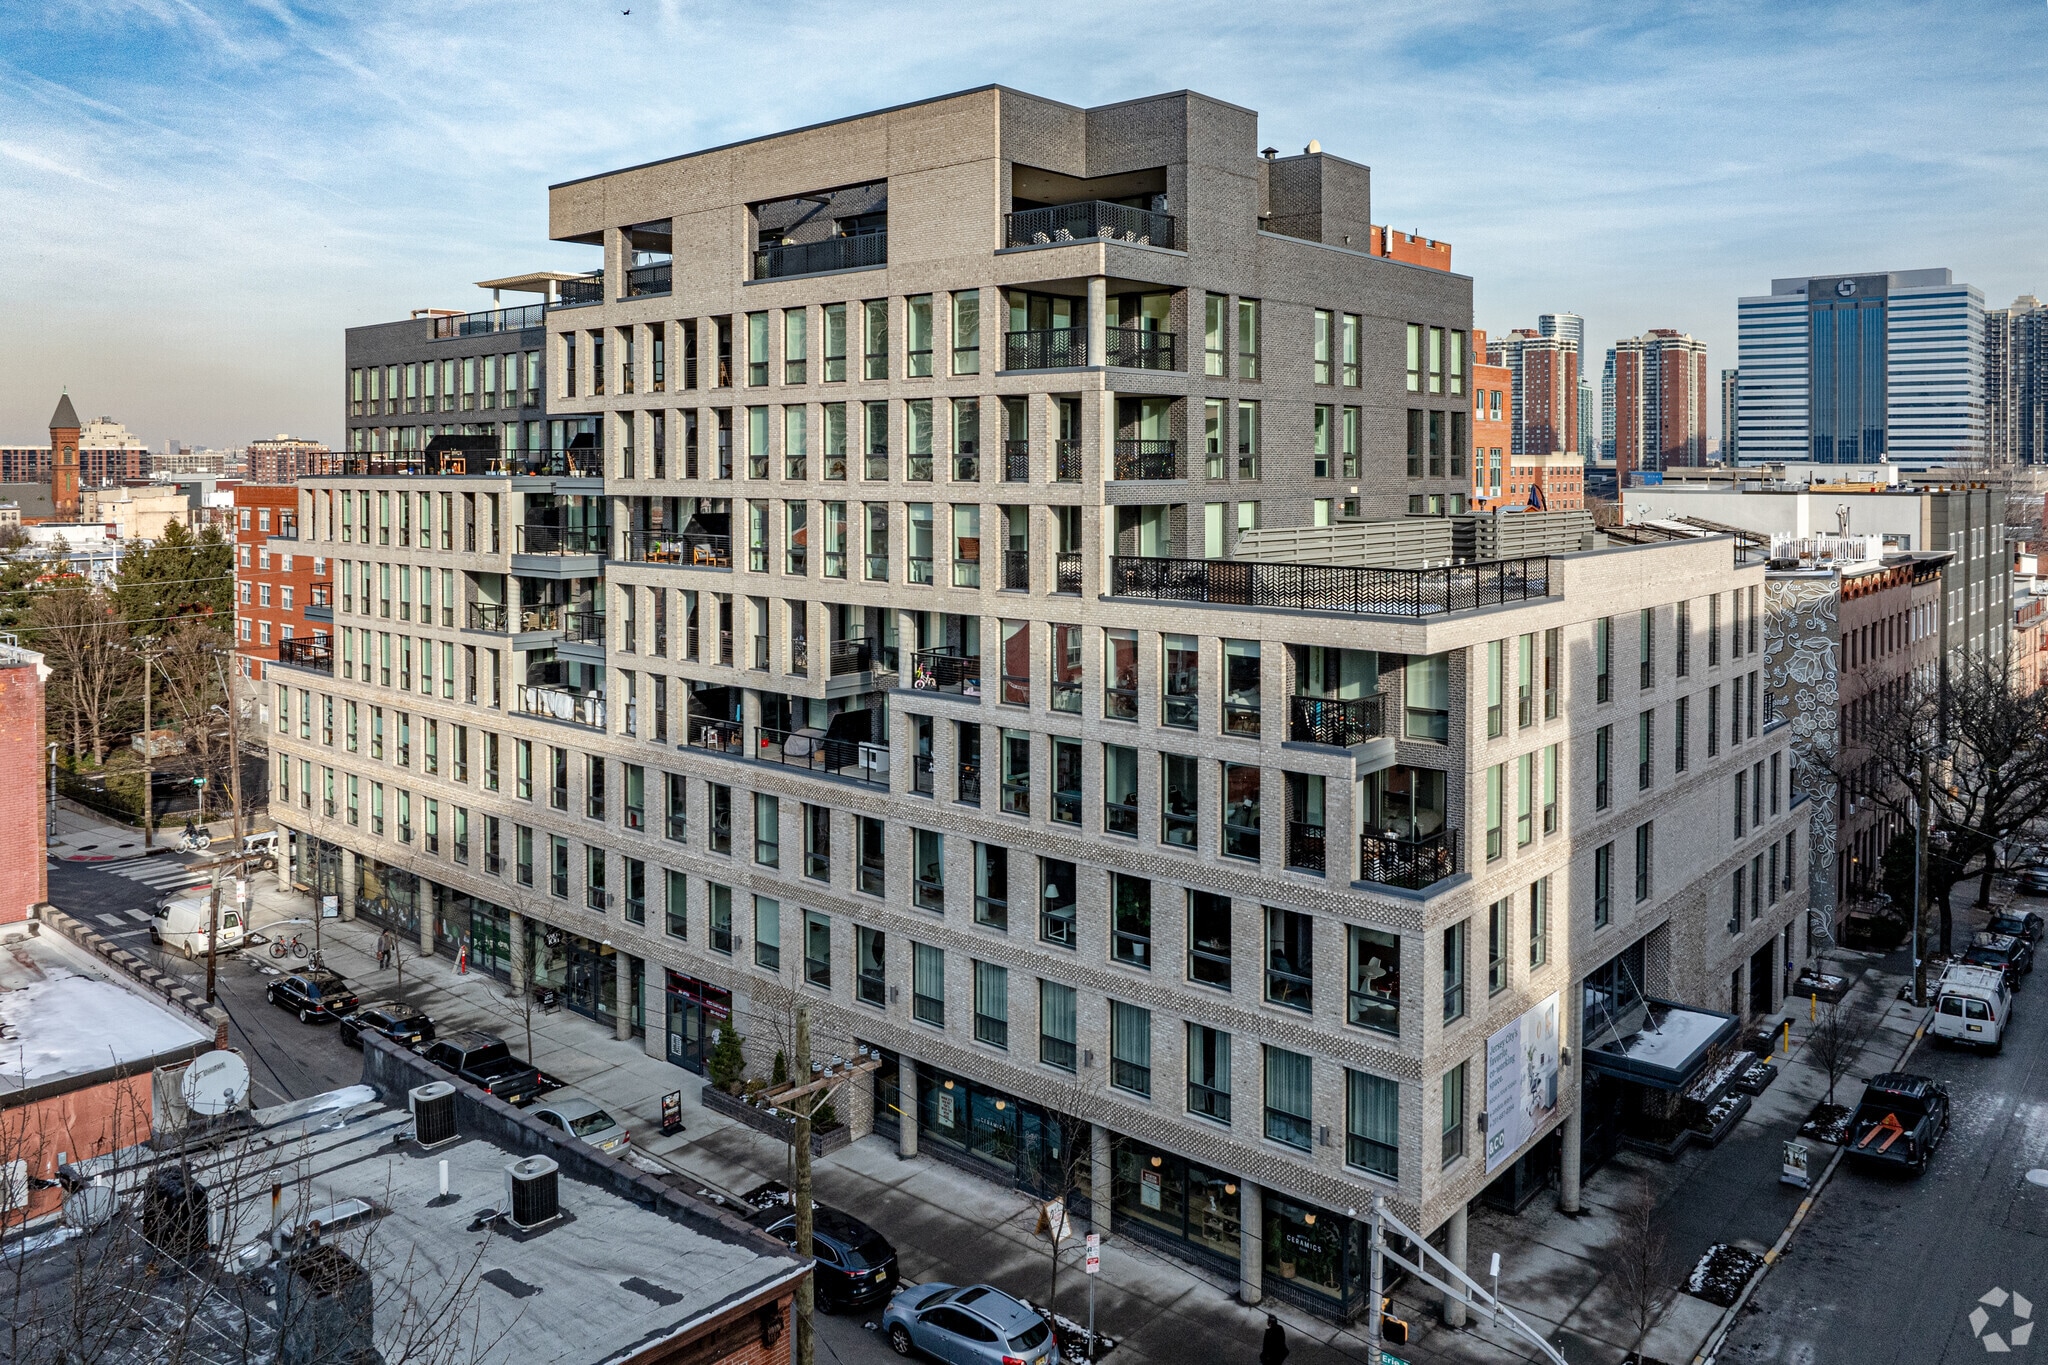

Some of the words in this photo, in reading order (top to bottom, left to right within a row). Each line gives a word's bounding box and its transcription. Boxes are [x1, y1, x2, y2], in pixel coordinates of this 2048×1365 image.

[1490, 1040, 1505, 1055] Jersey
[1506, 1029, 1518, 1044] City's
[1489, 1049, 1508, 1067] favorite
[1489, 1054, 1515, 1079] co-working
[1489, 1132, 1505, 1156] &CO
[1286, 1234, 1323, 1253] CERAMICS
[1382, 1354, 1400, 1365] Erie
